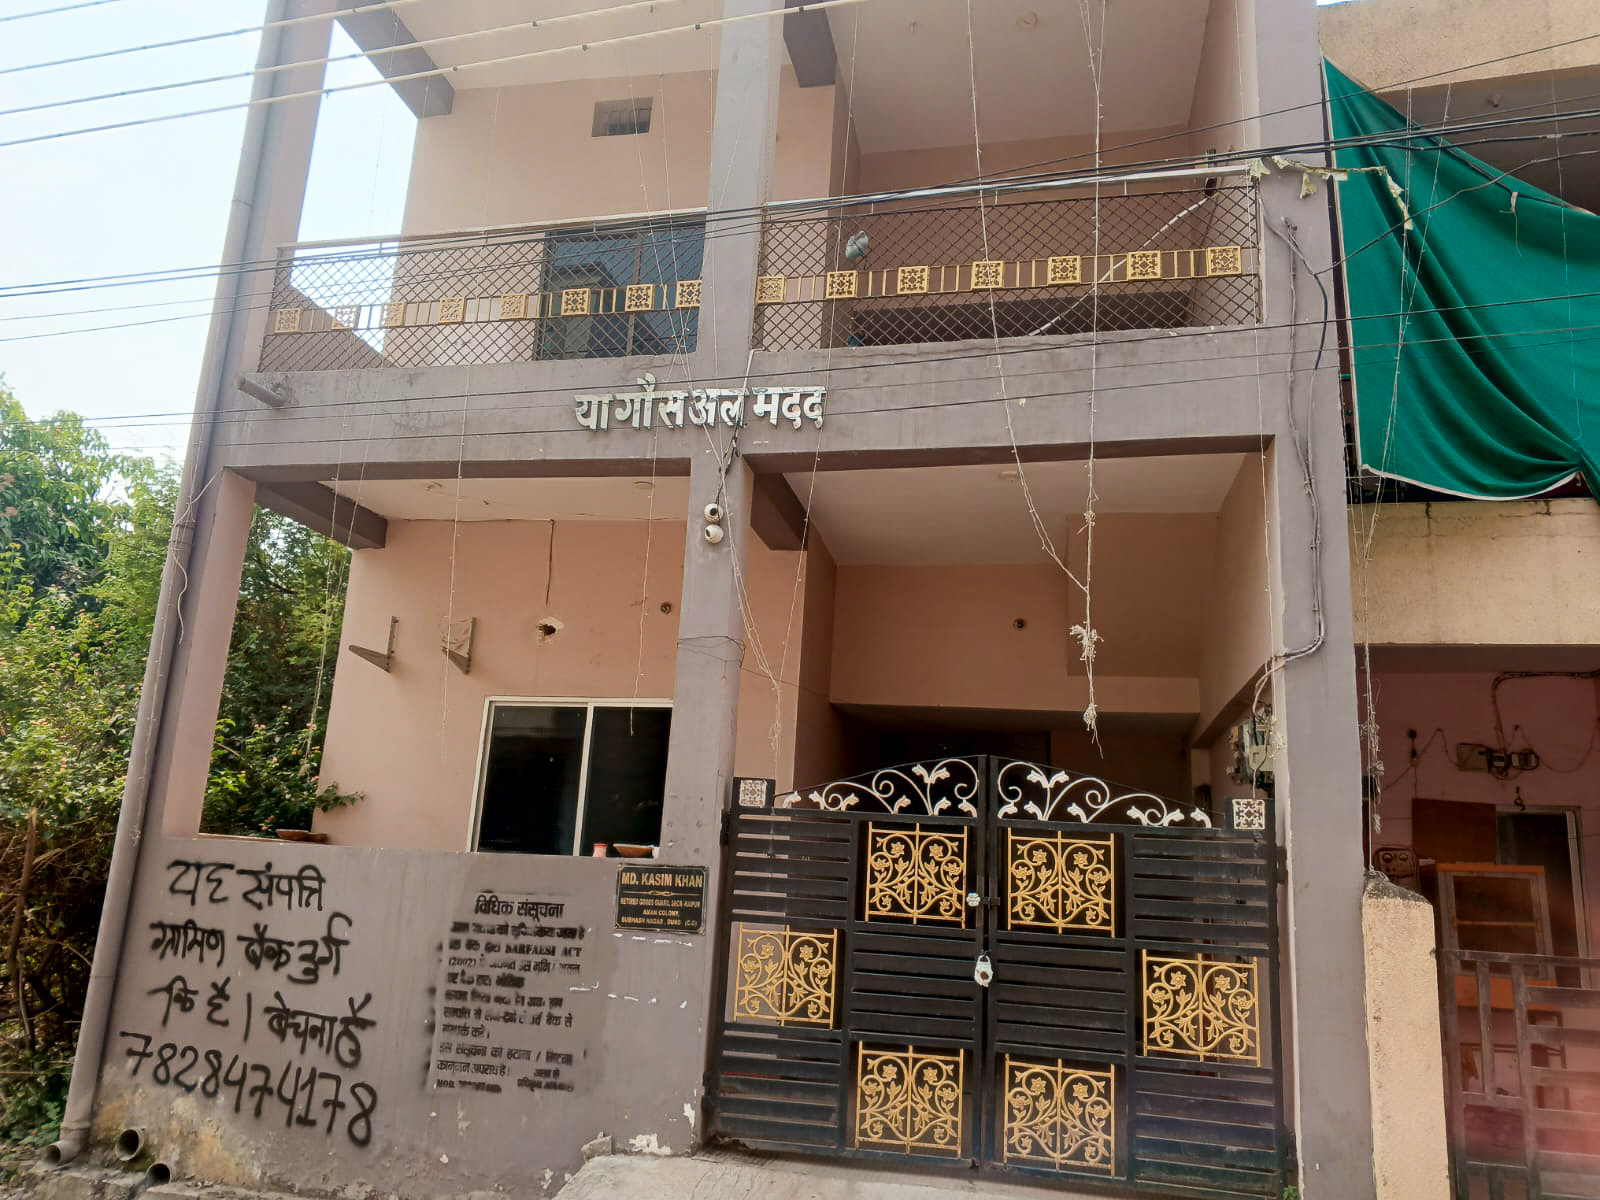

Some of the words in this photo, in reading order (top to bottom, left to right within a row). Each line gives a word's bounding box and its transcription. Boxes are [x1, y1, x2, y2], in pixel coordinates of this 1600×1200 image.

[574, 394, 610, 431] या
[614, 373, 688, 429] गौस
[752, 386, 827, 429] मदद
[167, 859, 235, 905] यह
[621, 872, 639, 885] MD.
[641, 873, 673, 886] KASIM
[674, 874, 703, 888] KHAN
[474, 894, 514, 915] विधिक
[517, 898, 565, 922] संसूचना
[561, 946, 583, 957] ACT
[147, 975, 199, 1027] कि
[119, 1031, 378, 1147] 7828474178
